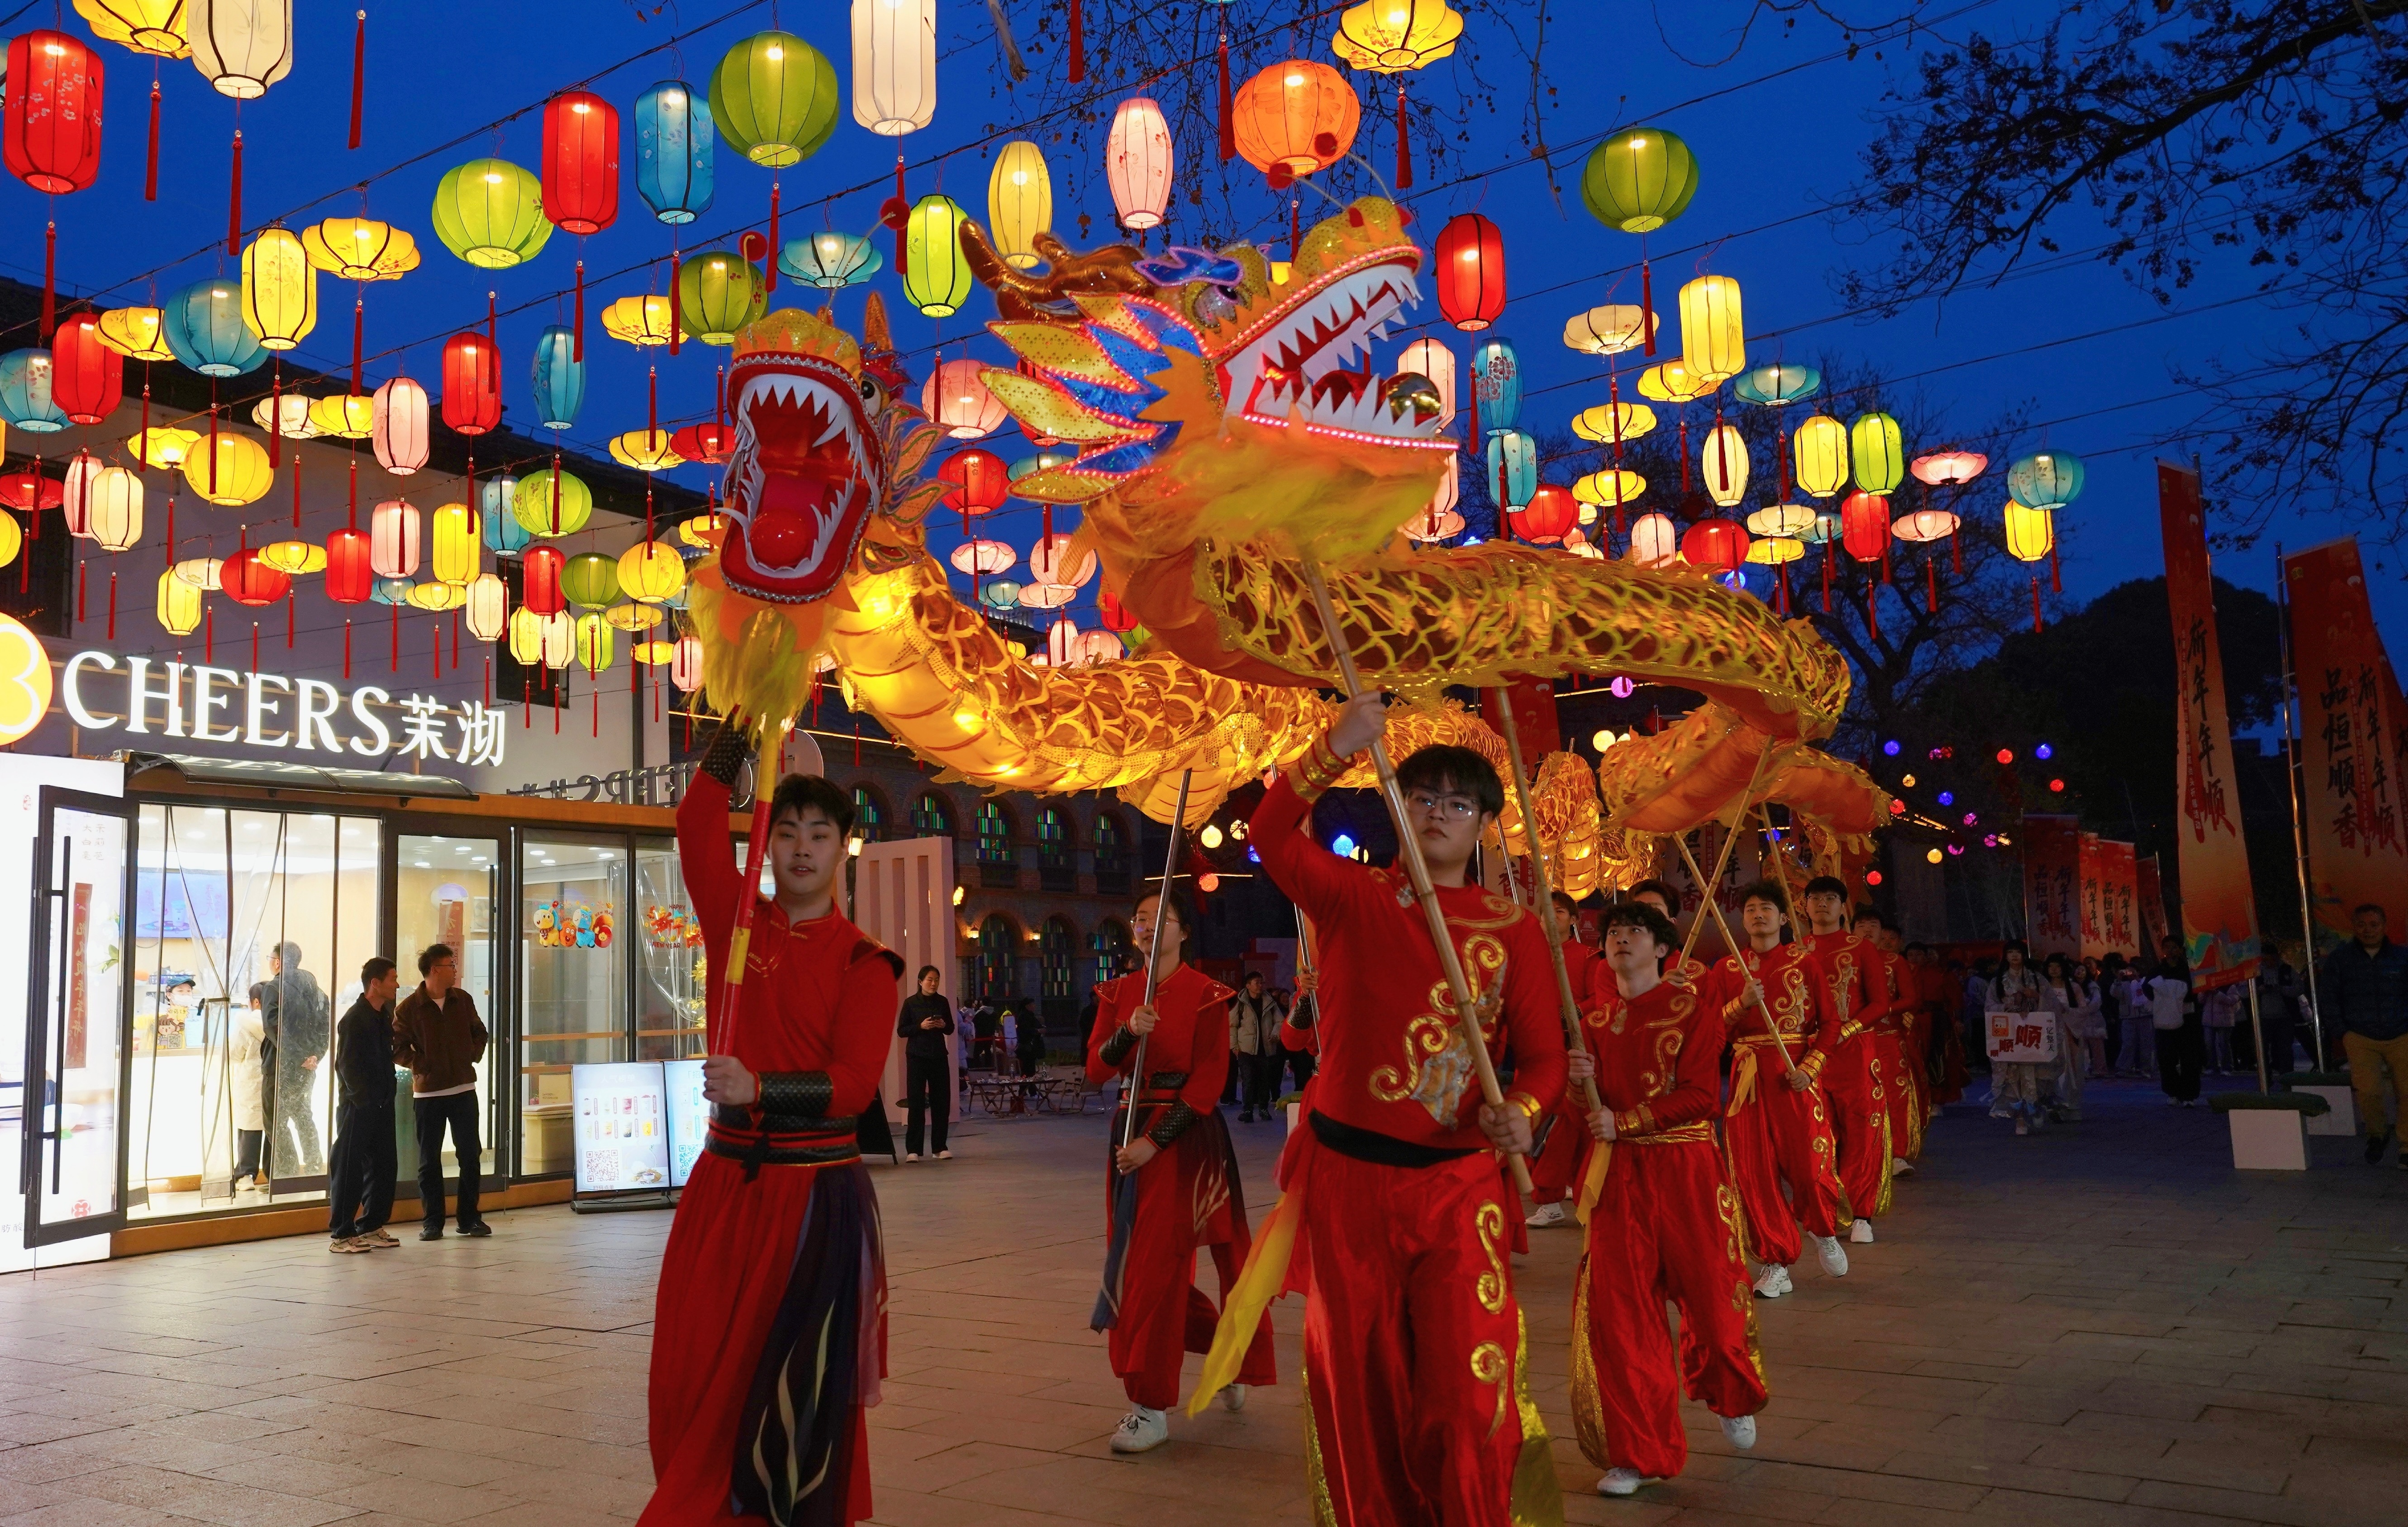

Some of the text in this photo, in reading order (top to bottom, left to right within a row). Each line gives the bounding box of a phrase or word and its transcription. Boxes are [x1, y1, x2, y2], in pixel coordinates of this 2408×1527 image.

[63, 651, 505, 767] CHEERS 茉沏
[2320, 667, 2358, 849] 品恒顺香
[1999, 1039, 2014, 1052] 顺
[2015, 1025, 2042, 1050] 顺
[600, 1074, 635, 1083] 人气榜单
